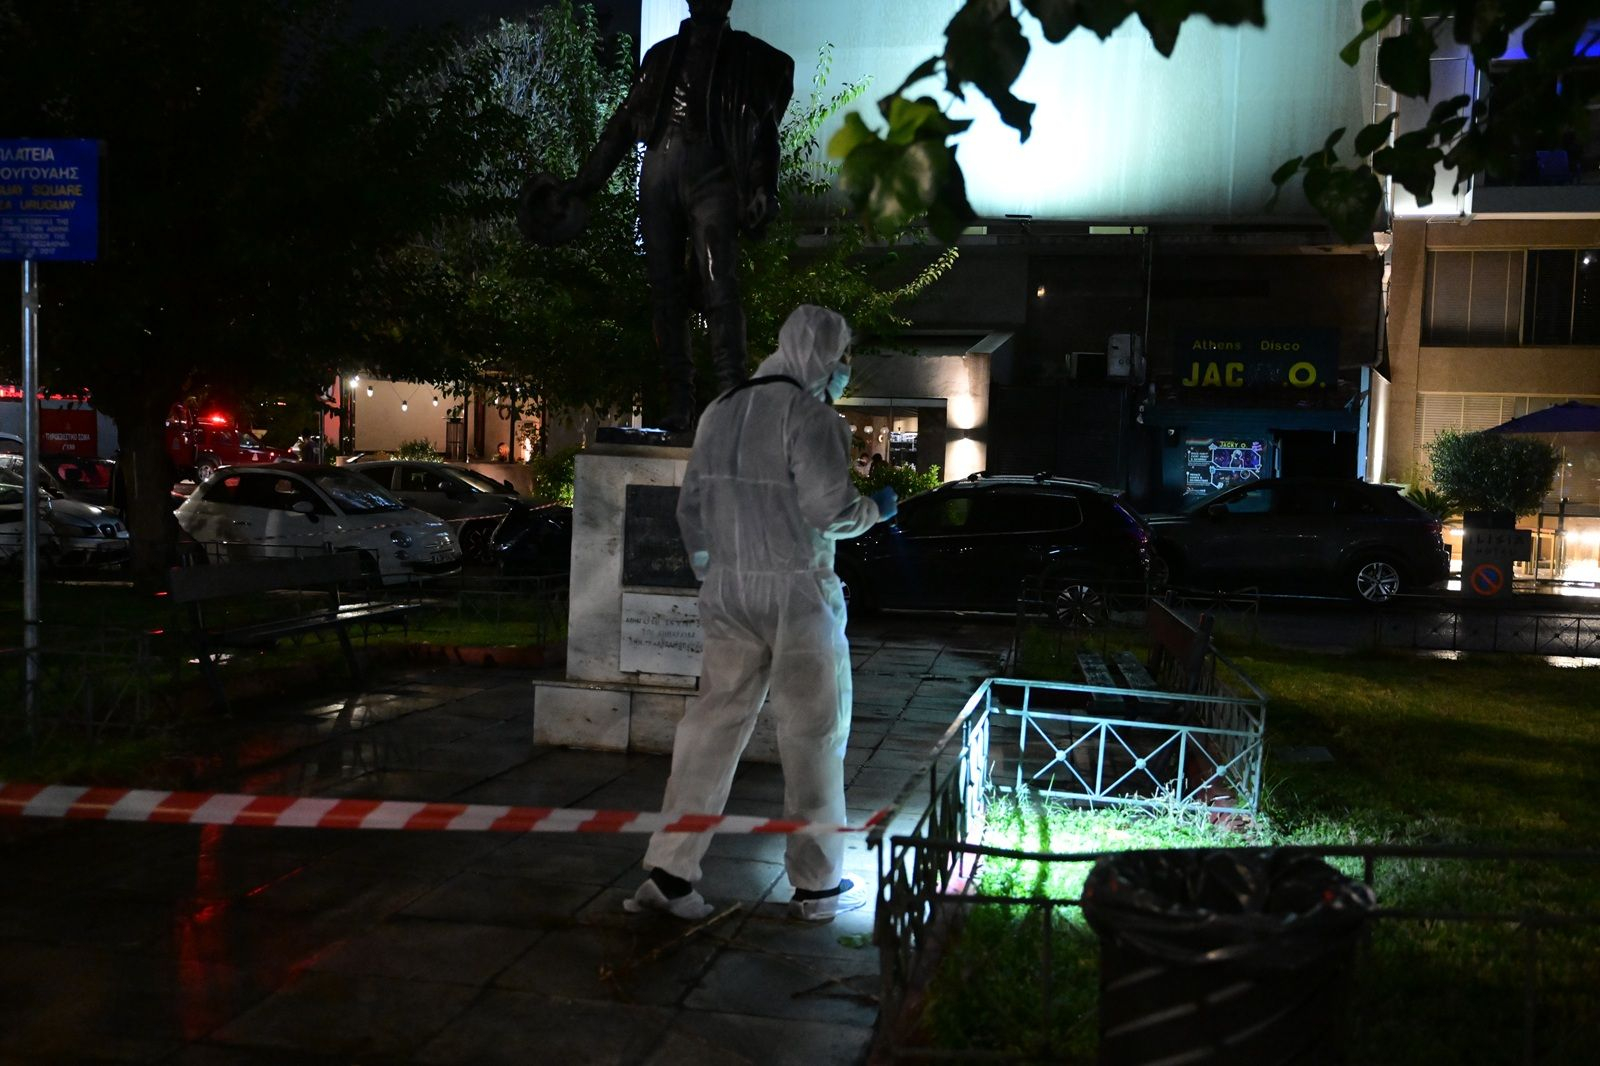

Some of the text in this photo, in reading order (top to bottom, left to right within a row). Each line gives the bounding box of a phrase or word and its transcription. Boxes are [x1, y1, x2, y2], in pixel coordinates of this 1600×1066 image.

[31, 185, 83, 196] SQUARE
[20, 201, 76, 210] URUGUAY
[1192, 339, 1300, 352] Athens Disco
